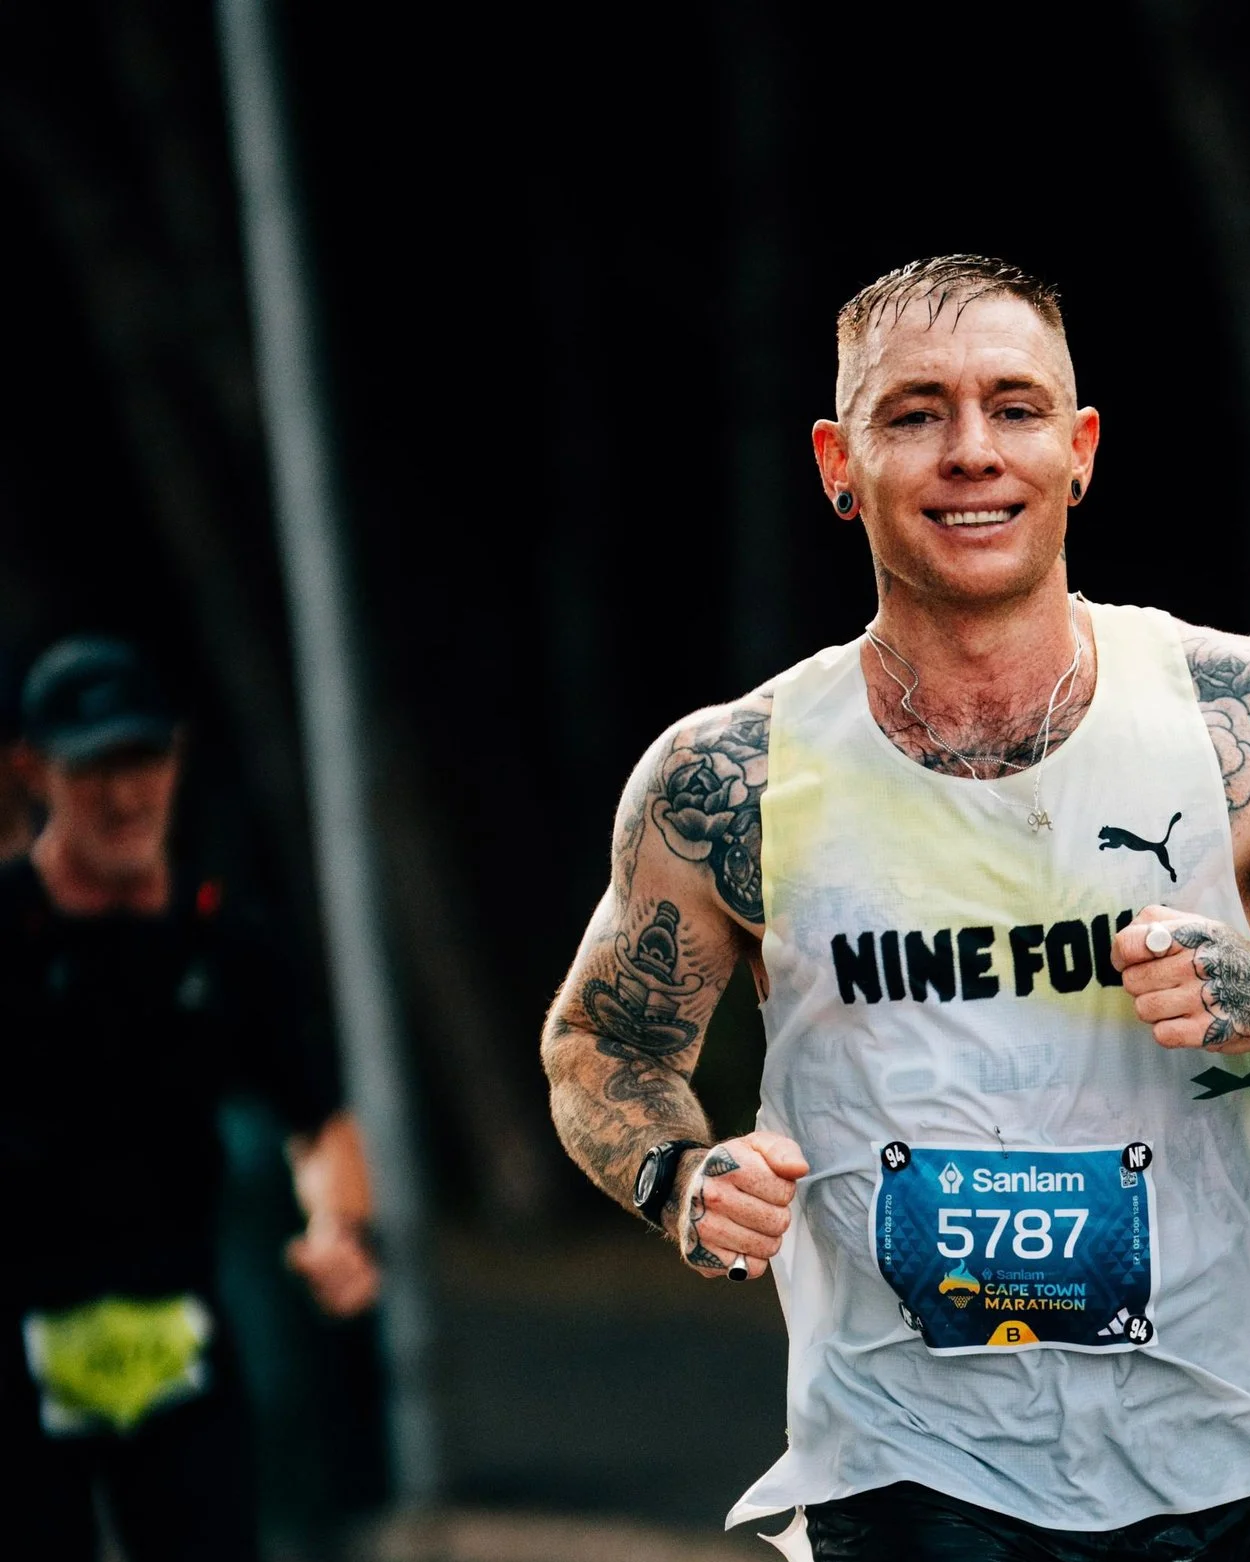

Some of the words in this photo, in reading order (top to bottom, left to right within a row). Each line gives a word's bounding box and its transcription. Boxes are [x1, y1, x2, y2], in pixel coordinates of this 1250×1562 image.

[830, 926, 1000, 1005] NINE
[1008, 908, 1134, 998] FOU
[885, 1144, 906, 1169] 94
[1128, 1145, 1147, 1169] NF
[972, 1165, 1085, 1193] Sanlam
[936, 1207, 1090, 1260] 5787
[996, 1269, 1045, 1281] Sanlam
[984, 1283, 1029, 1296] CAPE
[1034, 1283, 1086, 1297] TOWN
[984, 1298, 1086, 1311] MARATHON
[1006, 1327, 1021, 1343] B
[1129, 1318, 1148, 1341] 94
